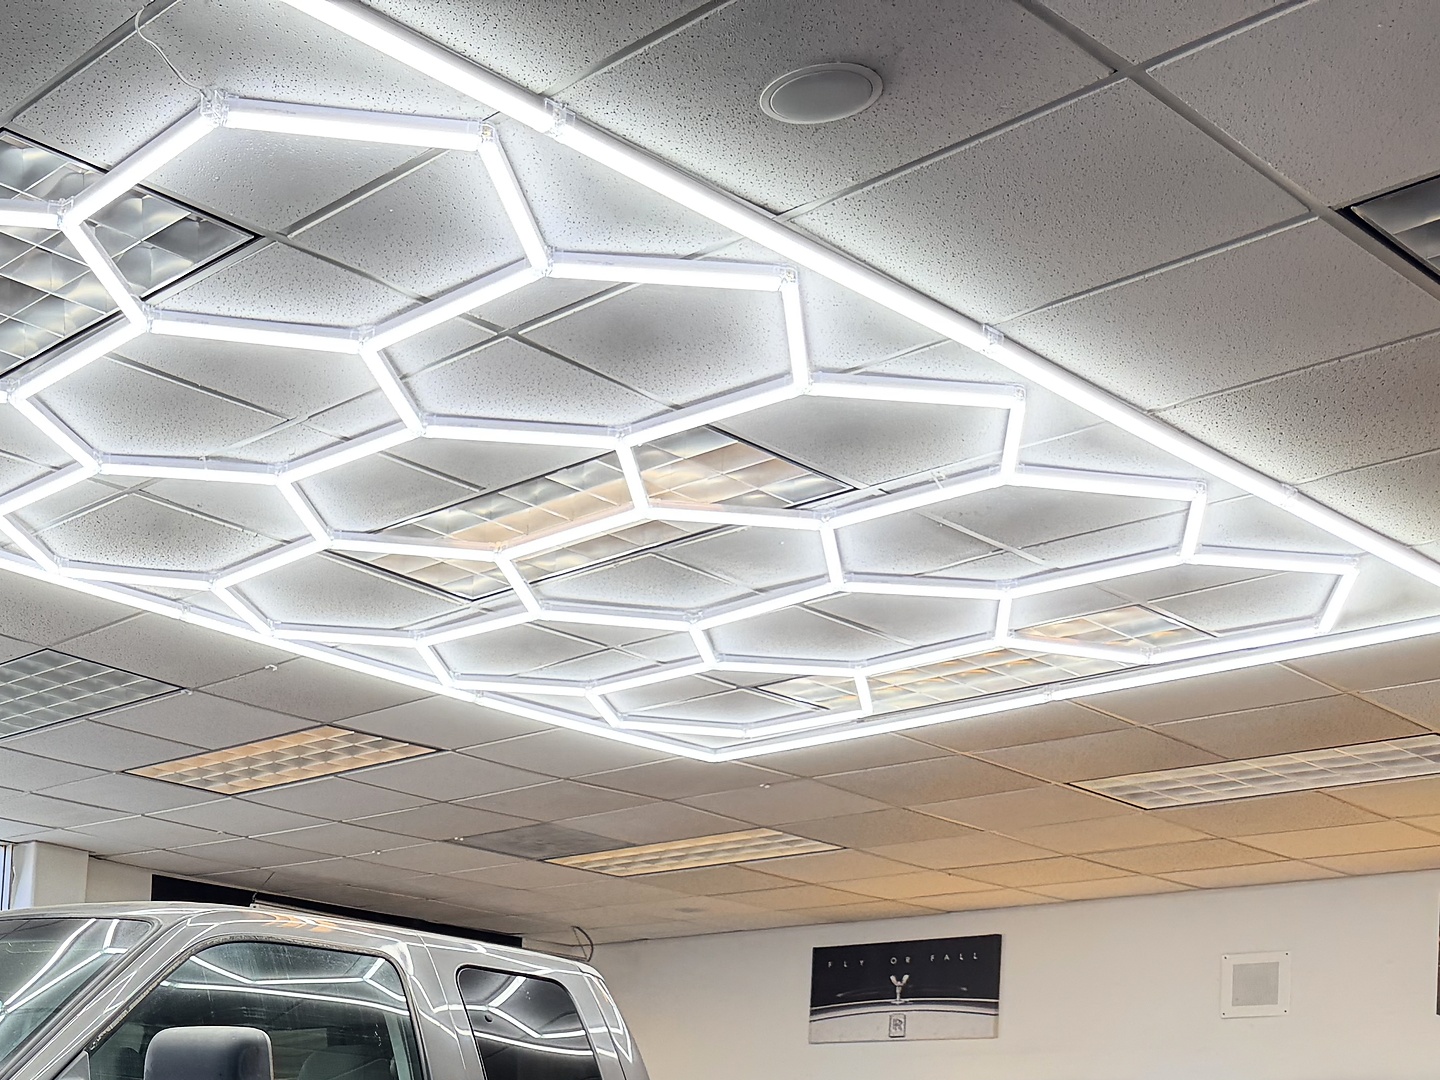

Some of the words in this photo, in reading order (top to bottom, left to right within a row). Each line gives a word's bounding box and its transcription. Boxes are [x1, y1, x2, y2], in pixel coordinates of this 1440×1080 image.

[828, 959, 865, 969] FLY
[890, 956, 911, 965] OR
[930, 952, 979, 962] FALL
